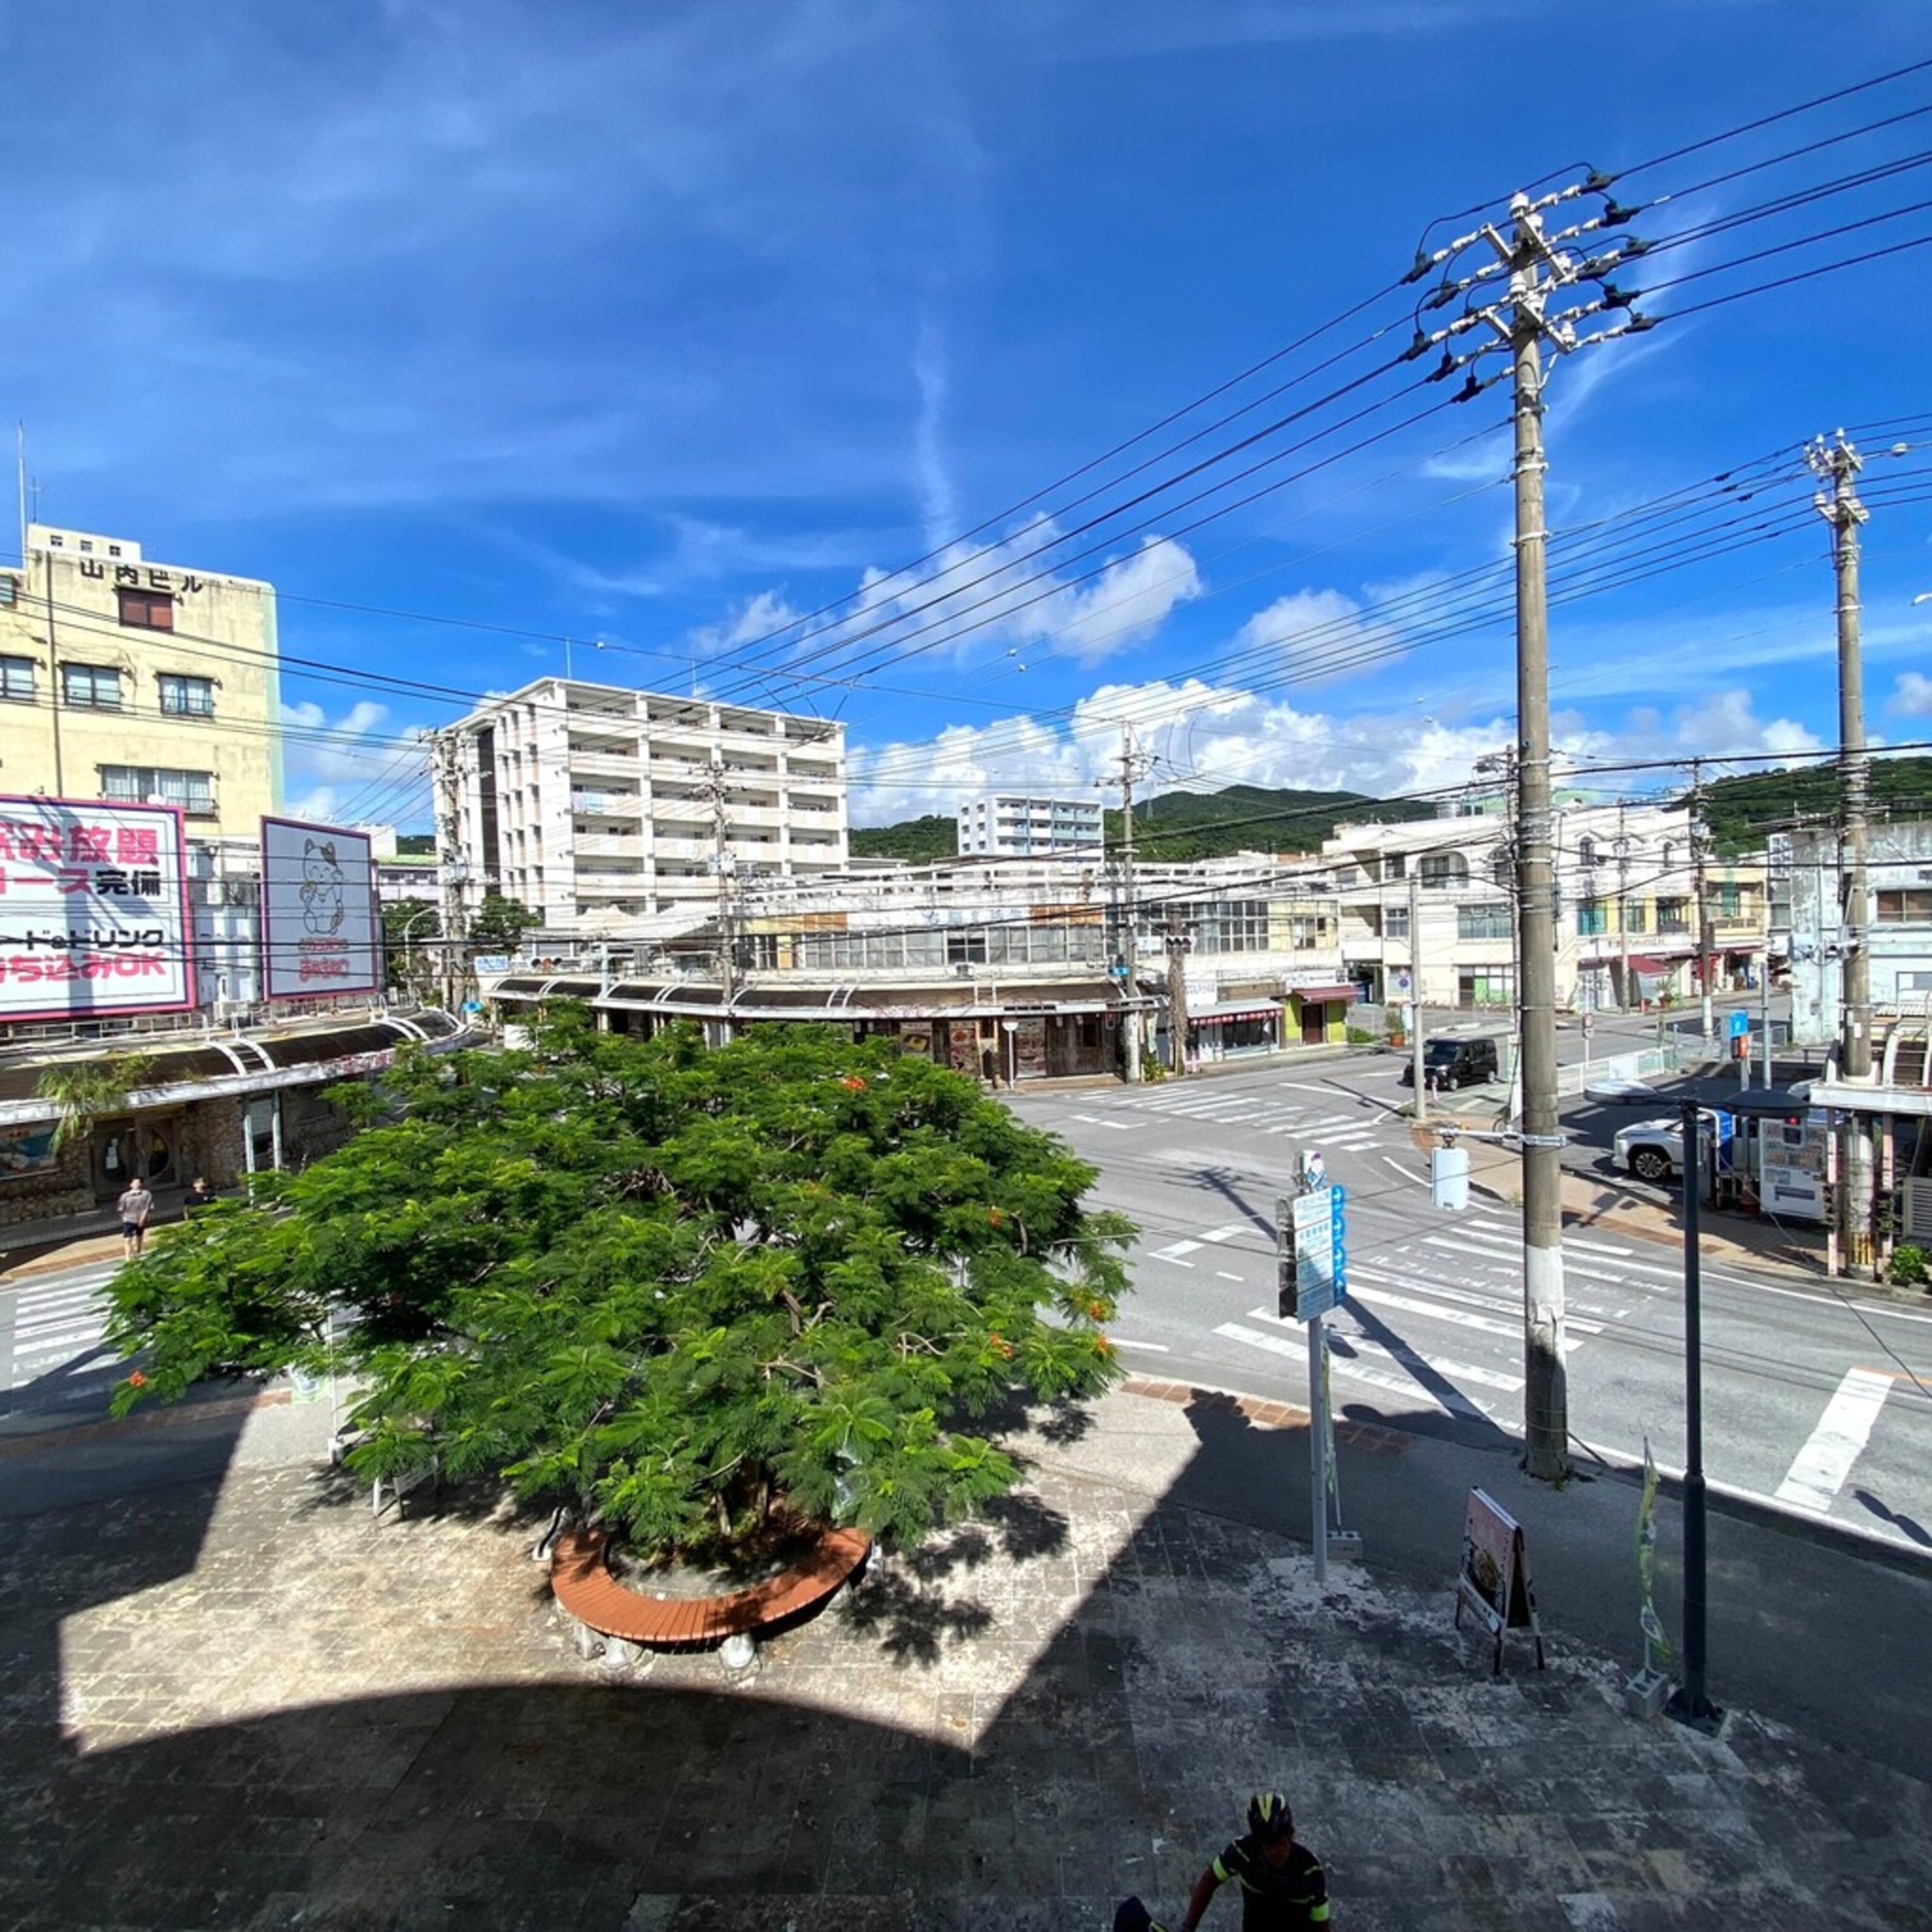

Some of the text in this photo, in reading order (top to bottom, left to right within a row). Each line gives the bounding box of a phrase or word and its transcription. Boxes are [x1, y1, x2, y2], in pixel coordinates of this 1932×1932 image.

[80, 558, 203, 593] 山内ビル
[0, 866, 161, 896] ース完備
[0, 951, 166, 983] ち込みOK
